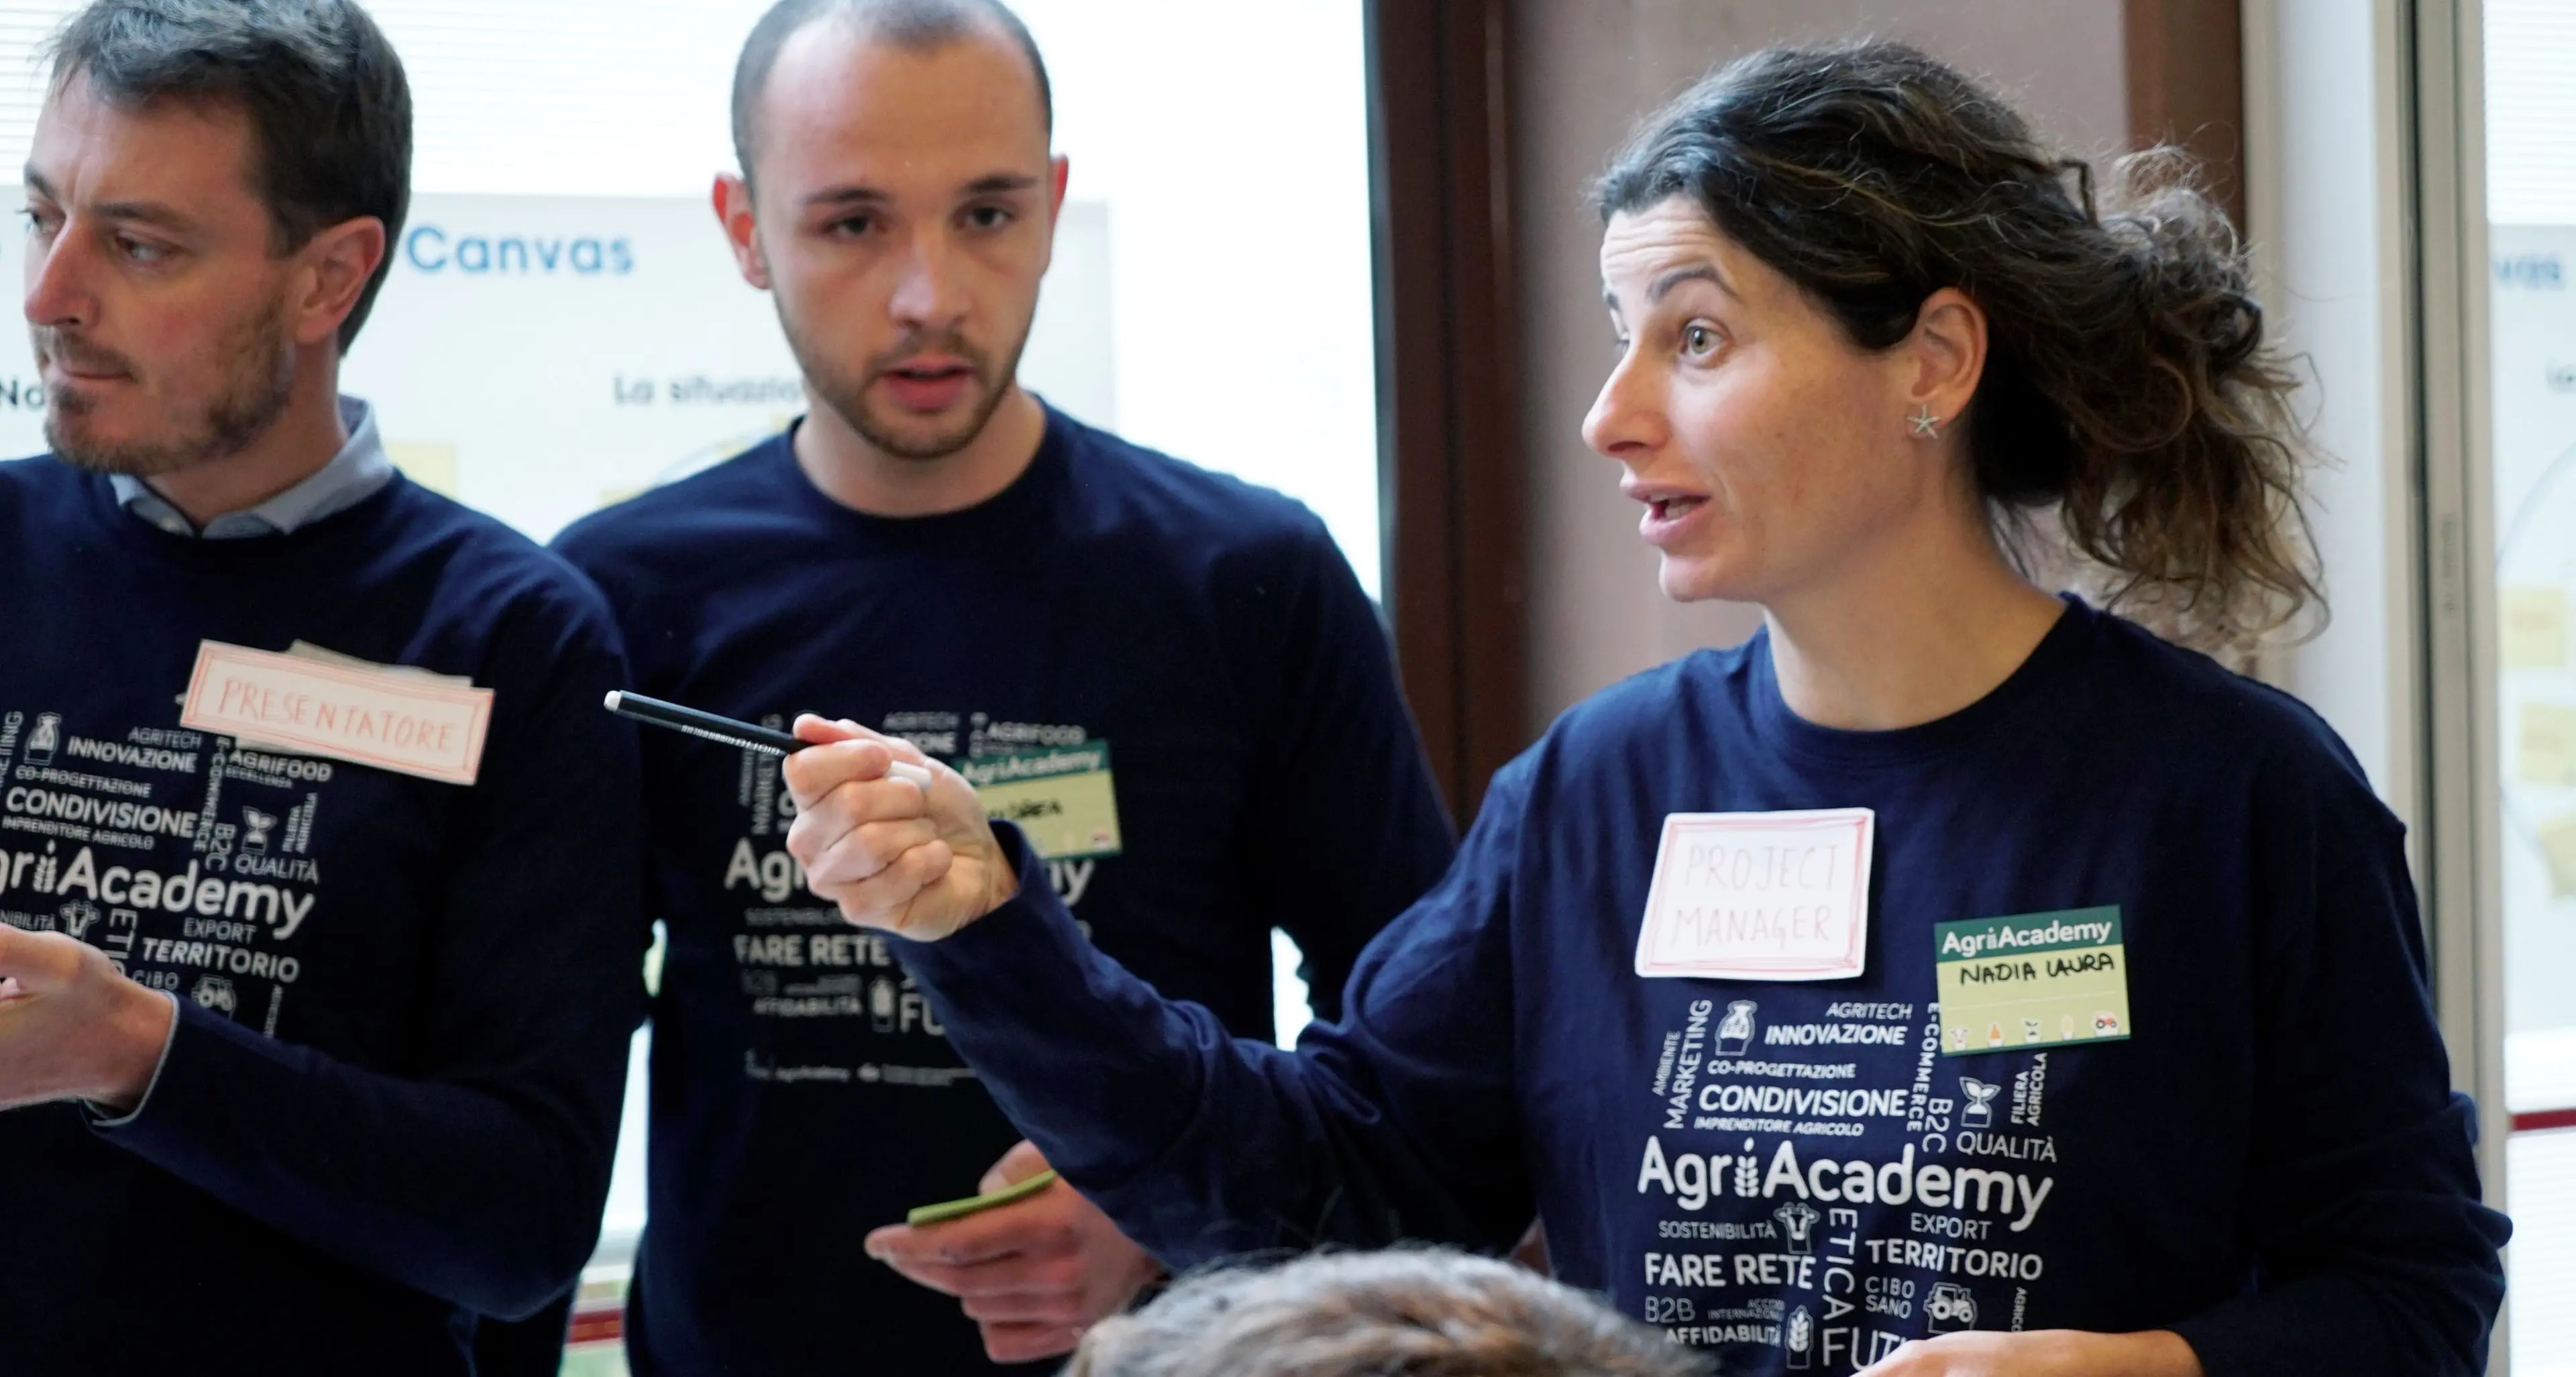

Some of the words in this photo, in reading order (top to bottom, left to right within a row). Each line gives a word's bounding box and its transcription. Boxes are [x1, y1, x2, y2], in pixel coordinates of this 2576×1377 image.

[406, 226, 634, 273] Canvas
[614, 376, 655, 404] La
[671, 376, 802, 404] situazio
[218, 676, 456, 753] PRESENTATORE
[67, 736, 199, 773] INNOVAZIONE
[127, 726, 202, 749] AGRITECH
[15, 765, 152, 798] CO-PROGETTAZIONE
[228, 749, 333, 782] AGRIFOOD
[6, 786, 199, 838] CONDIVISIONE
[2, 816, 91, 841] IMPRENDITORE
[91, 829, 155, 850] AGRICOLO
[205, 823, 236, 871] B2C
[235, 852, 319, 885] QUALITÀ
[1684, 844, 1839, 892] PROJECT
[0, 840, 315, 940] riAcademy
[0, 909, 56, 931] NIBILITÀ
[183, 917, 257, 944] EXPORT
[1671, 905, 1833, 949] MANAGER
[1942, 919, 2112, 957] AgriAcademy
[142, 937, 300, 983] TERRITORIO
[734, 934, 804, 966] FARE
[809, 934, 891, 966] RETE
[133, 971, 180, 991] CIBO
[1960, 960, 2037, 987] NADIA
[2046, 952, 2114, 977] LAURA
[1825, 1001, 1913, 1020] AGRITECH
[1764, 1024, 1909, 1046] INNOVAZIONE
[1652, 1030, 1681, 1096] AMBIENTE
[1663, 999, 1713, 1130] MARKETING
[1707, 1060, 1856, 1079] CO-PROGETTAZIONE
[1907, 1002, 1941, 1132] E-COMMERCE
[1699, 1084, 1909, 1117] CONDIVISIONE
[2011, 1070, 2030, 1125] FILIERA
[2026, 1052, 2048, 1127] AGRICOLA
[1694, 1116, 1792, 1134] IMPRENDITORE
[1792, 1121, 1864, 1136] AGRICOLO
[1922, 1098, 1953, 1154] B2C
[1956, 1131, 2057, 1163] QUALITÀ
[1637, 1136, 2053, 1231] AgriAcademy
[1658, 1219, 1778, 1240] SOSTENIBILITÀ
[1911, 1212, 1992, 1240] EXPORT
[1644, 1252, 1727, 1287] FARE
[1733, 1254, 1817, 1289] RETE
[1821, 1208, 1858, 1321] ETICA
[1865, 1239, 2043, 1281] TERRITORIO
[1865, 1276, 1915, 1299] CIBO
[1645, 1295, 1695, 1323] B2B
[1865, 1295, 1912, 1320] SANO
[2011, 1286, 2028, 1332] AGRICO
[1823, 1326, 1907, 1372] FUT
